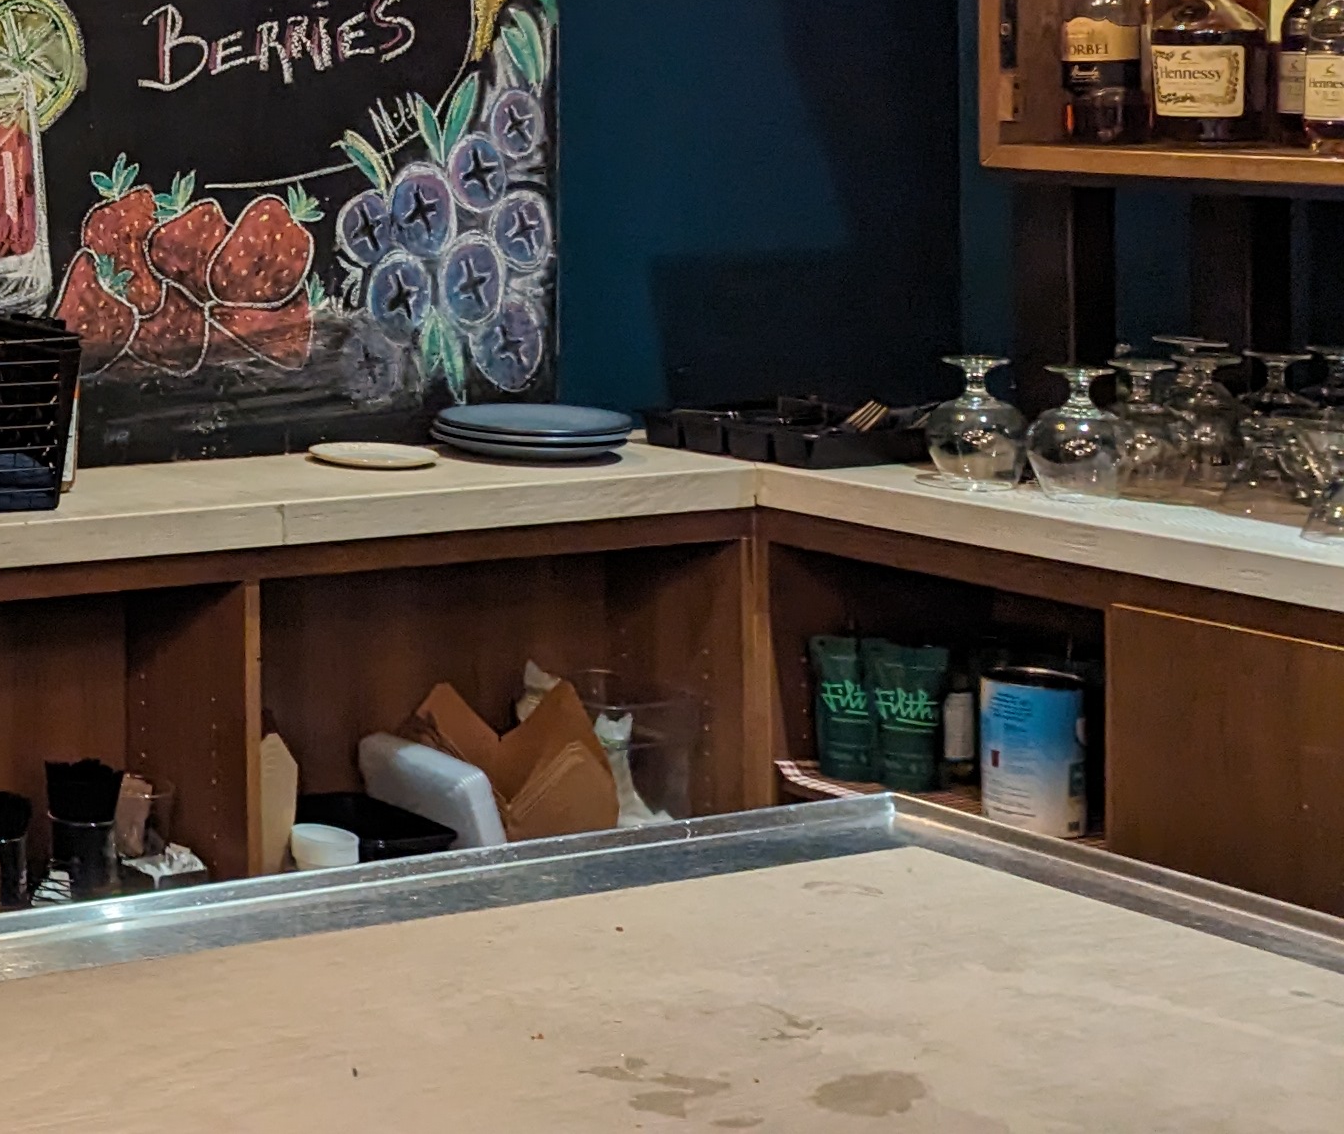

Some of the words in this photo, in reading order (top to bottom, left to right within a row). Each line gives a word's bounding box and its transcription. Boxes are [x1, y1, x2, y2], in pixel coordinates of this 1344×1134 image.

[1159, 67, 1224, 81] Hennessy
[820, 679, 869, 713] Filt
[875, 687, 939, 720] Filth
